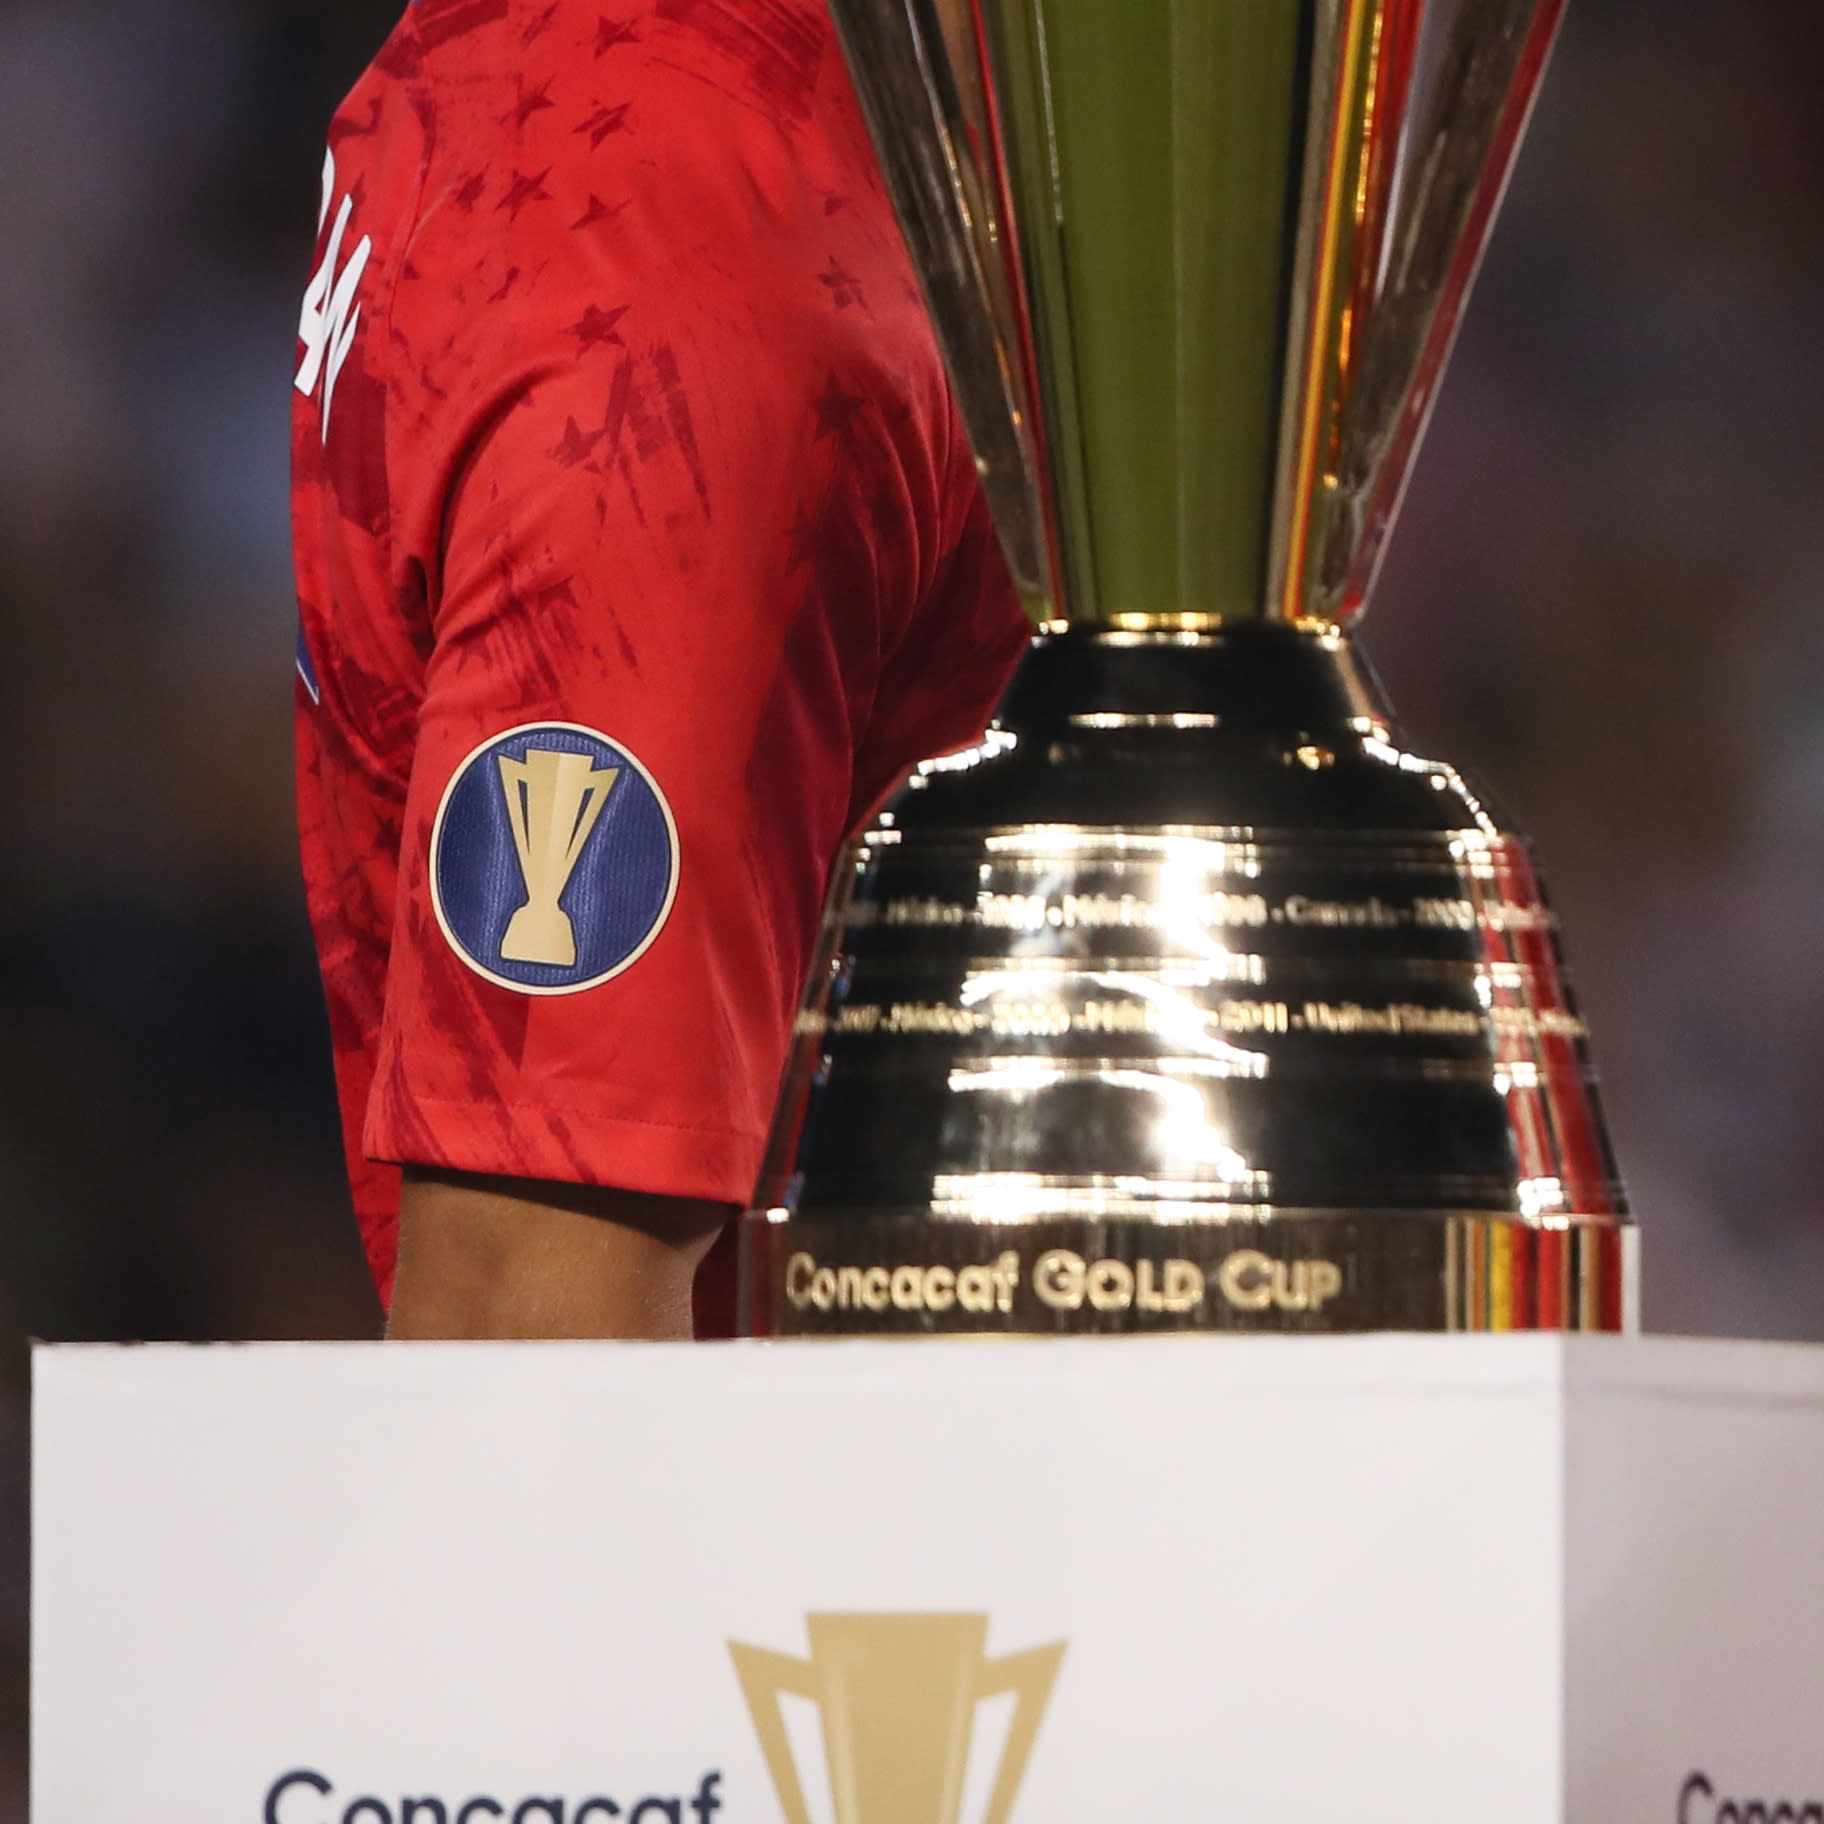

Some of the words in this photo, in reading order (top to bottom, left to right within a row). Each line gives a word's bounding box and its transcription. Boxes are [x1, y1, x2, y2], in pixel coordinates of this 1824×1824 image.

[786, 1250, 1019, 1313] Concacaf
[1032, 1248, 1204, 1312] GOLD
[1219, 1248, 1342, 1312] CUP
